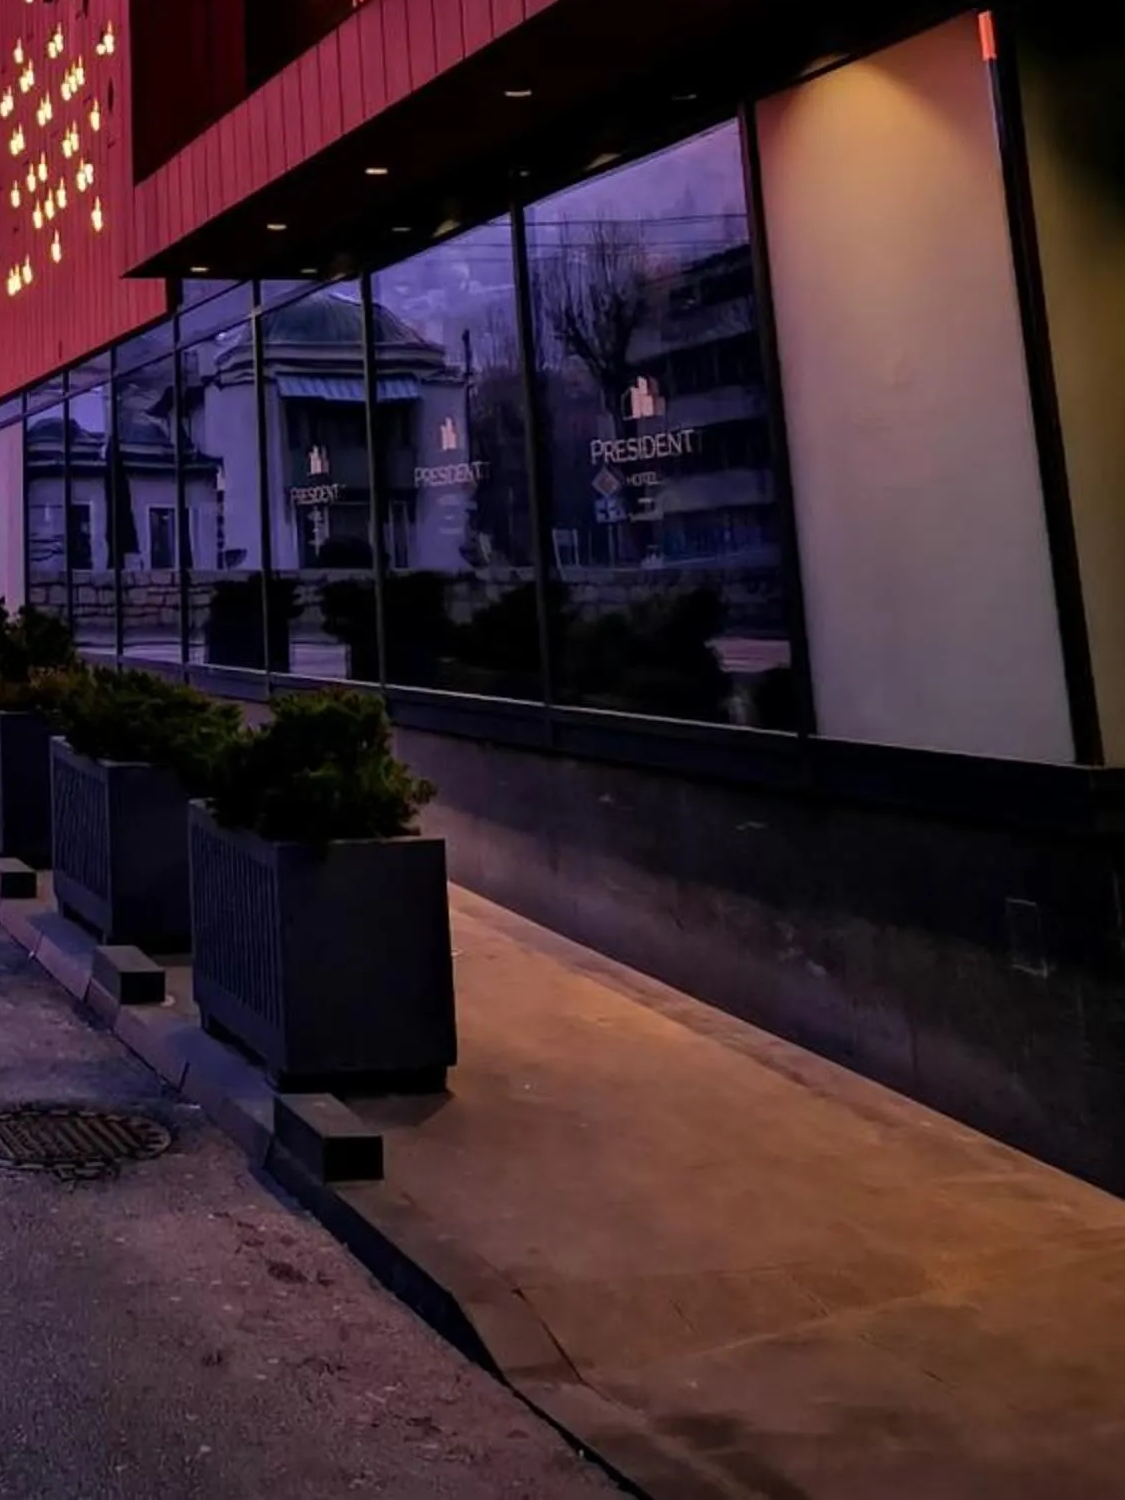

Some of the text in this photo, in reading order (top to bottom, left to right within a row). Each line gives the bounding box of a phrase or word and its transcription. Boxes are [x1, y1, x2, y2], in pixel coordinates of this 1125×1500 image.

[590, 429, 695, 465] PRESIDENT
[414, 461, 485, 488] PRESIDENT
[626, 471, 660, 487] HOTEL
